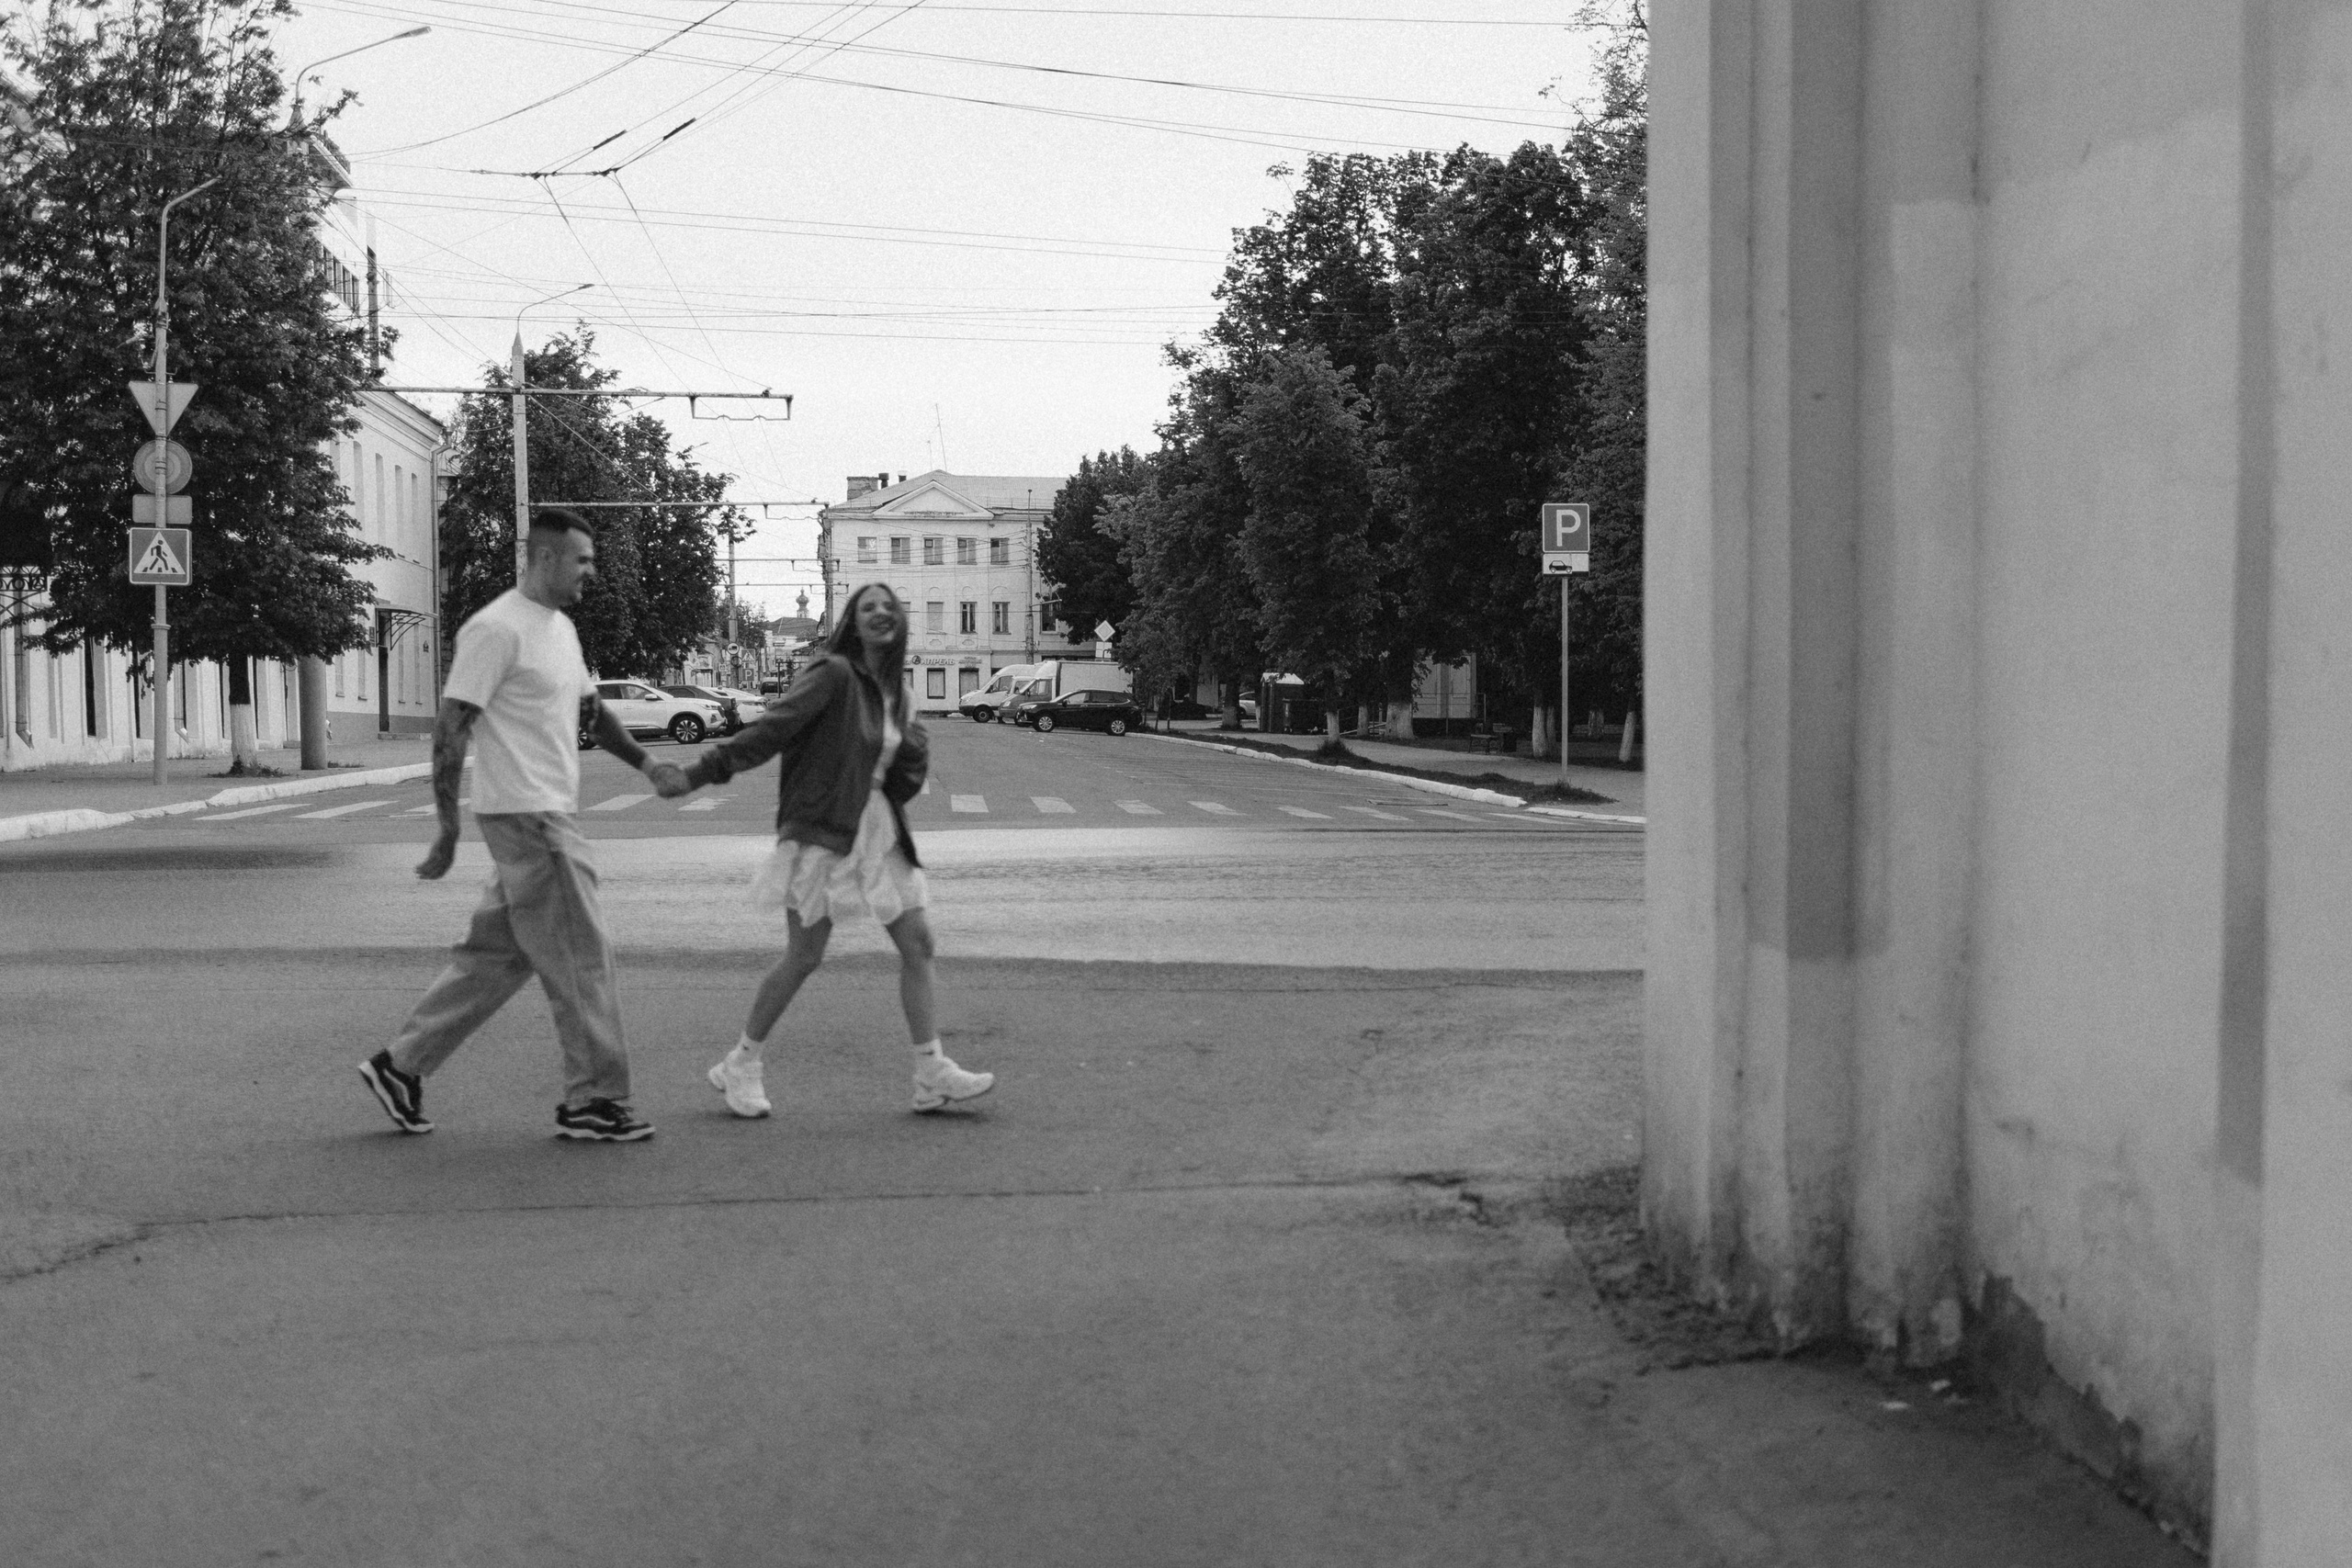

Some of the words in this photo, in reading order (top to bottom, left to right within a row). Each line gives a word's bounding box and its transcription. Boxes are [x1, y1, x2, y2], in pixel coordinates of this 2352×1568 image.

[1556, 509, 1581, 547] P
[922, 658, 955, 666] АПРЕЛЬ
[745, 670, 752, 680] P
